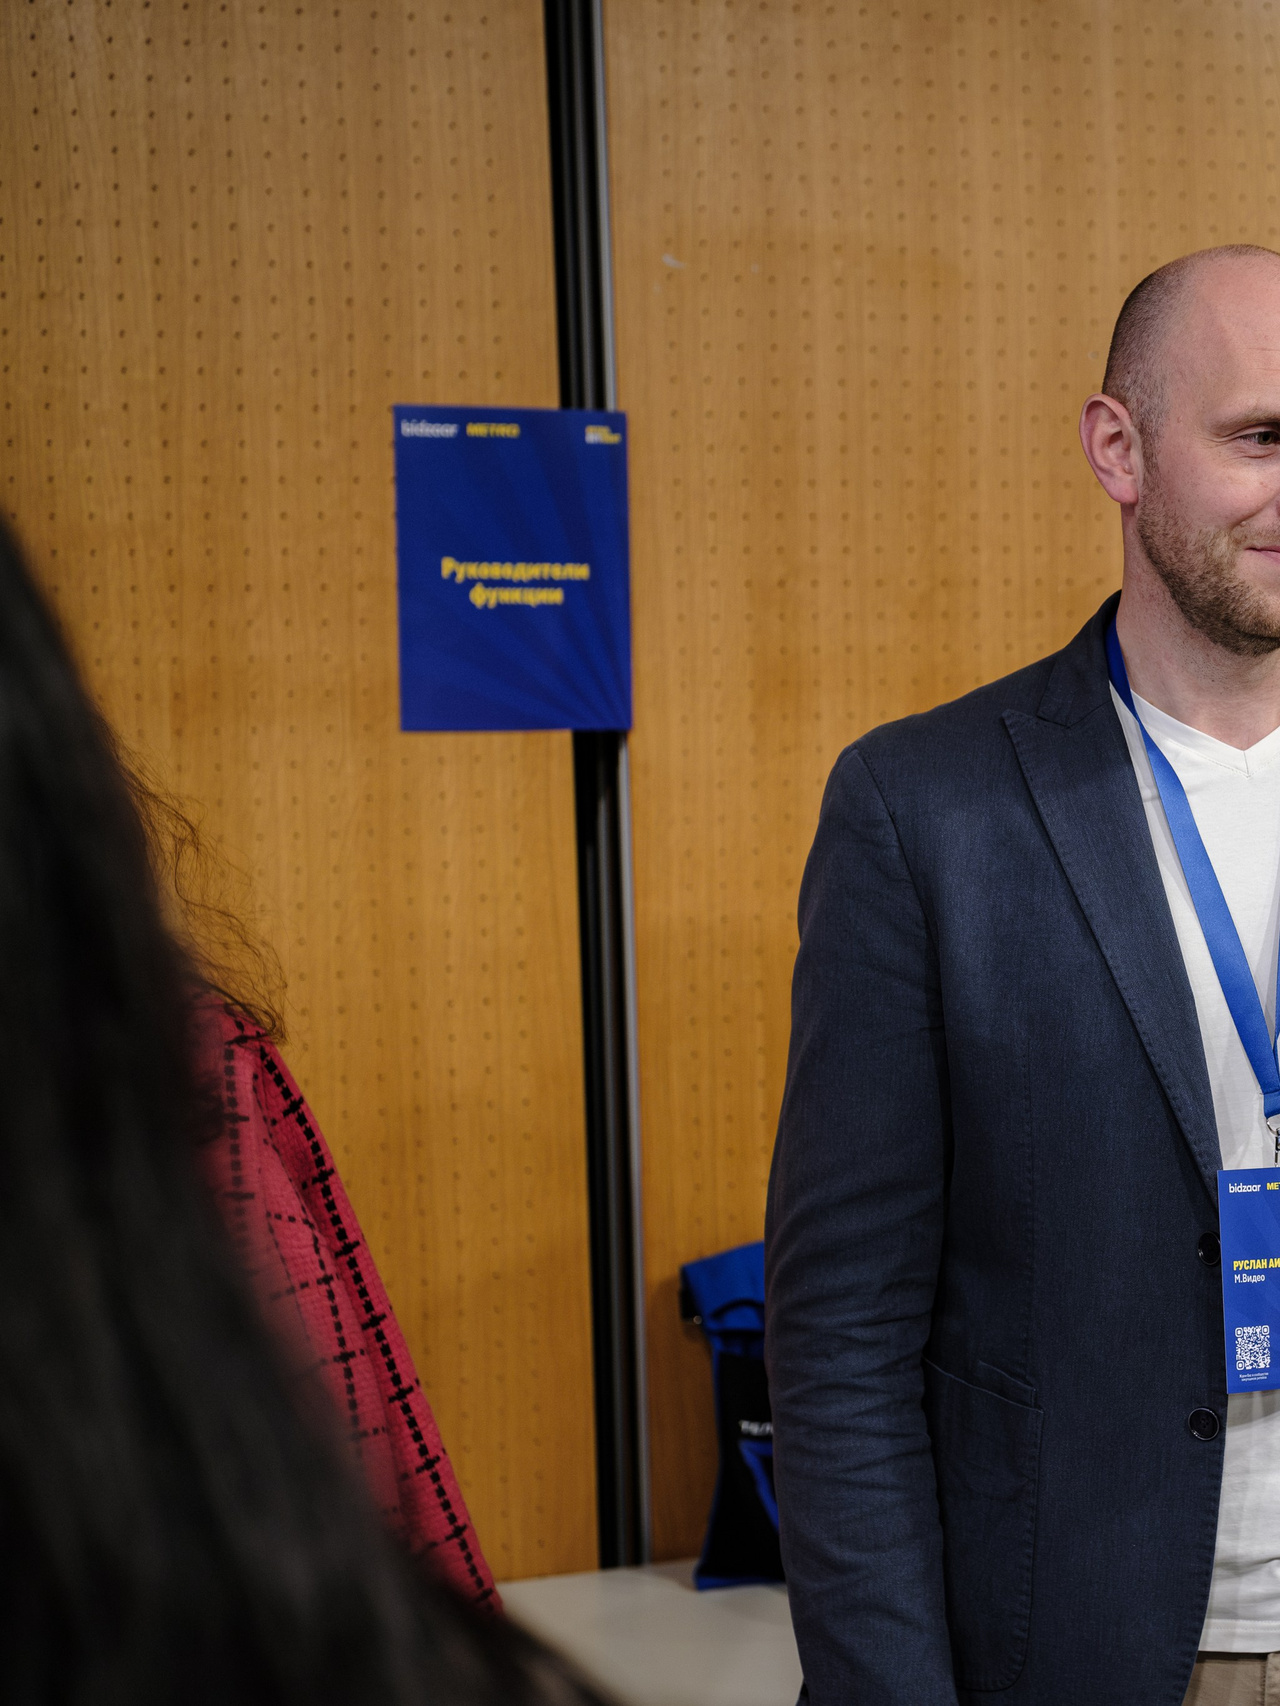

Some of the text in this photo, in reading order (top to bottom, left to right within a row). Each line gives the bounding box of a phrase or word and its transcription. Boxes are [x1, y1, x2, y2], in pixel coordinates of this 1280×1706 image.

[466, 422, 520, 438] METRO
[441, 556, 590, 583] Руководители
[1228, 1183, 1261, 1193] bidzaar
[1233, 1258, 1267, 1271] РУСЛАН
[1234, 1273, 1265, 1284] М.Видео
